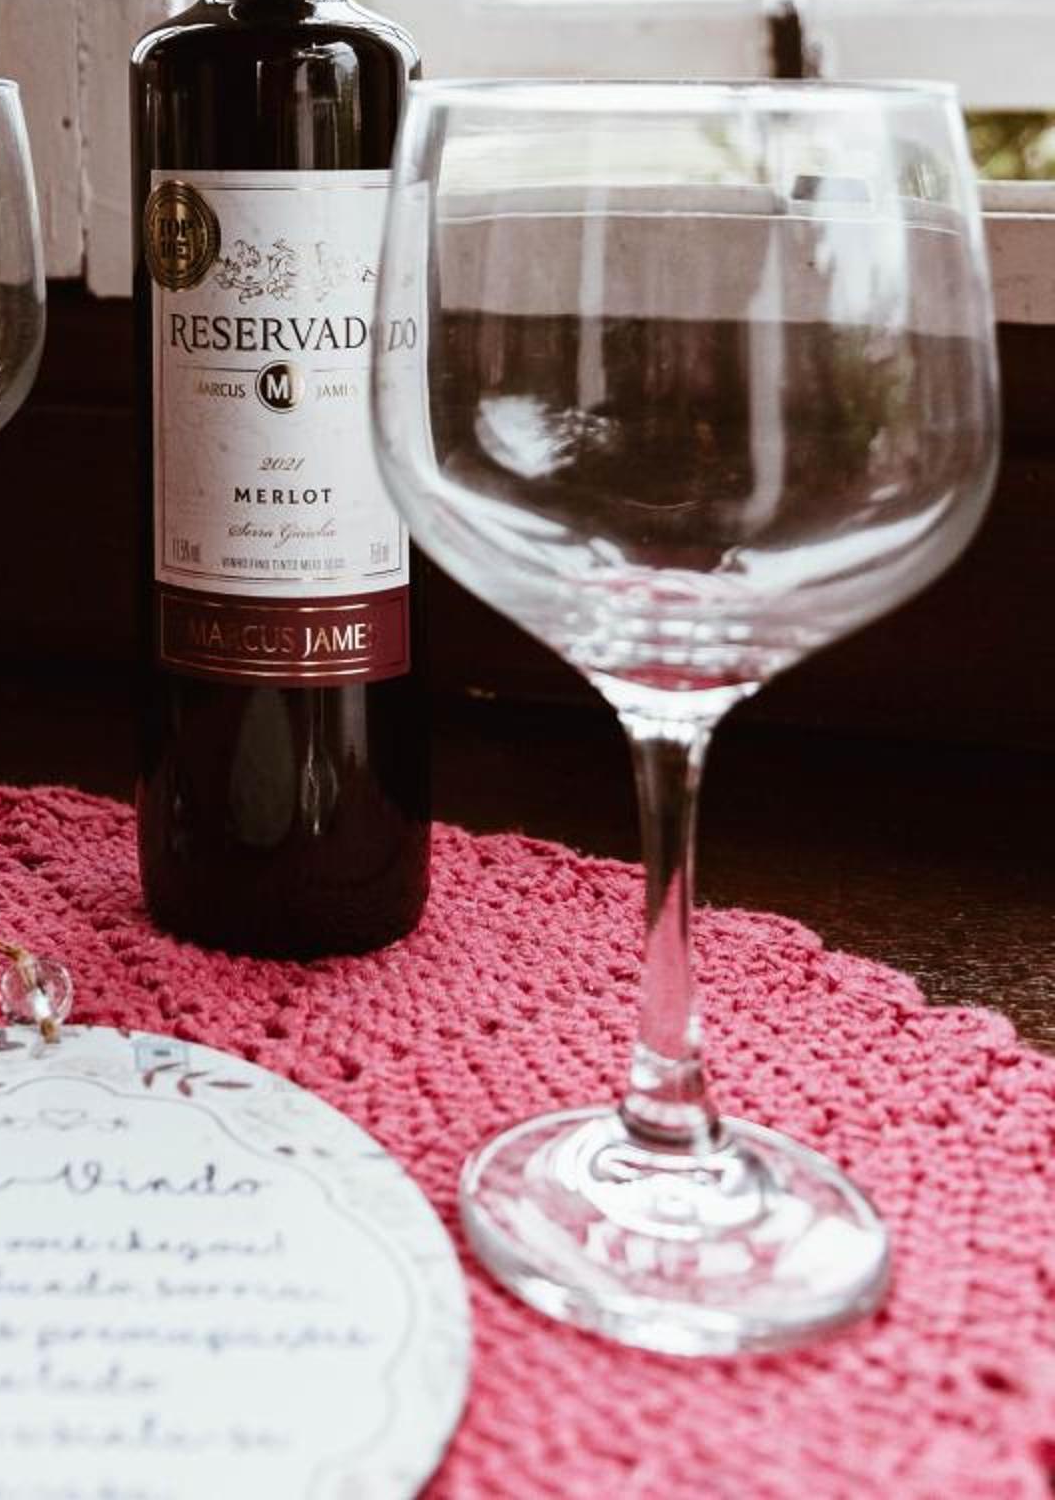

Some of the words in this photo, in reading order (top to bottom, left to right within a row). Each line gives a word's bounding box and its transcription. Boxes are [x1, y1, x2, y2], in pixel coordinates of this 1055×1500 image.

[257, 455, 306, 472] 2021
[233, 487, 333, 505] MERLOT
[190, 618, 296, 655] MACUS
[301, 622, 373, 660] JAME
